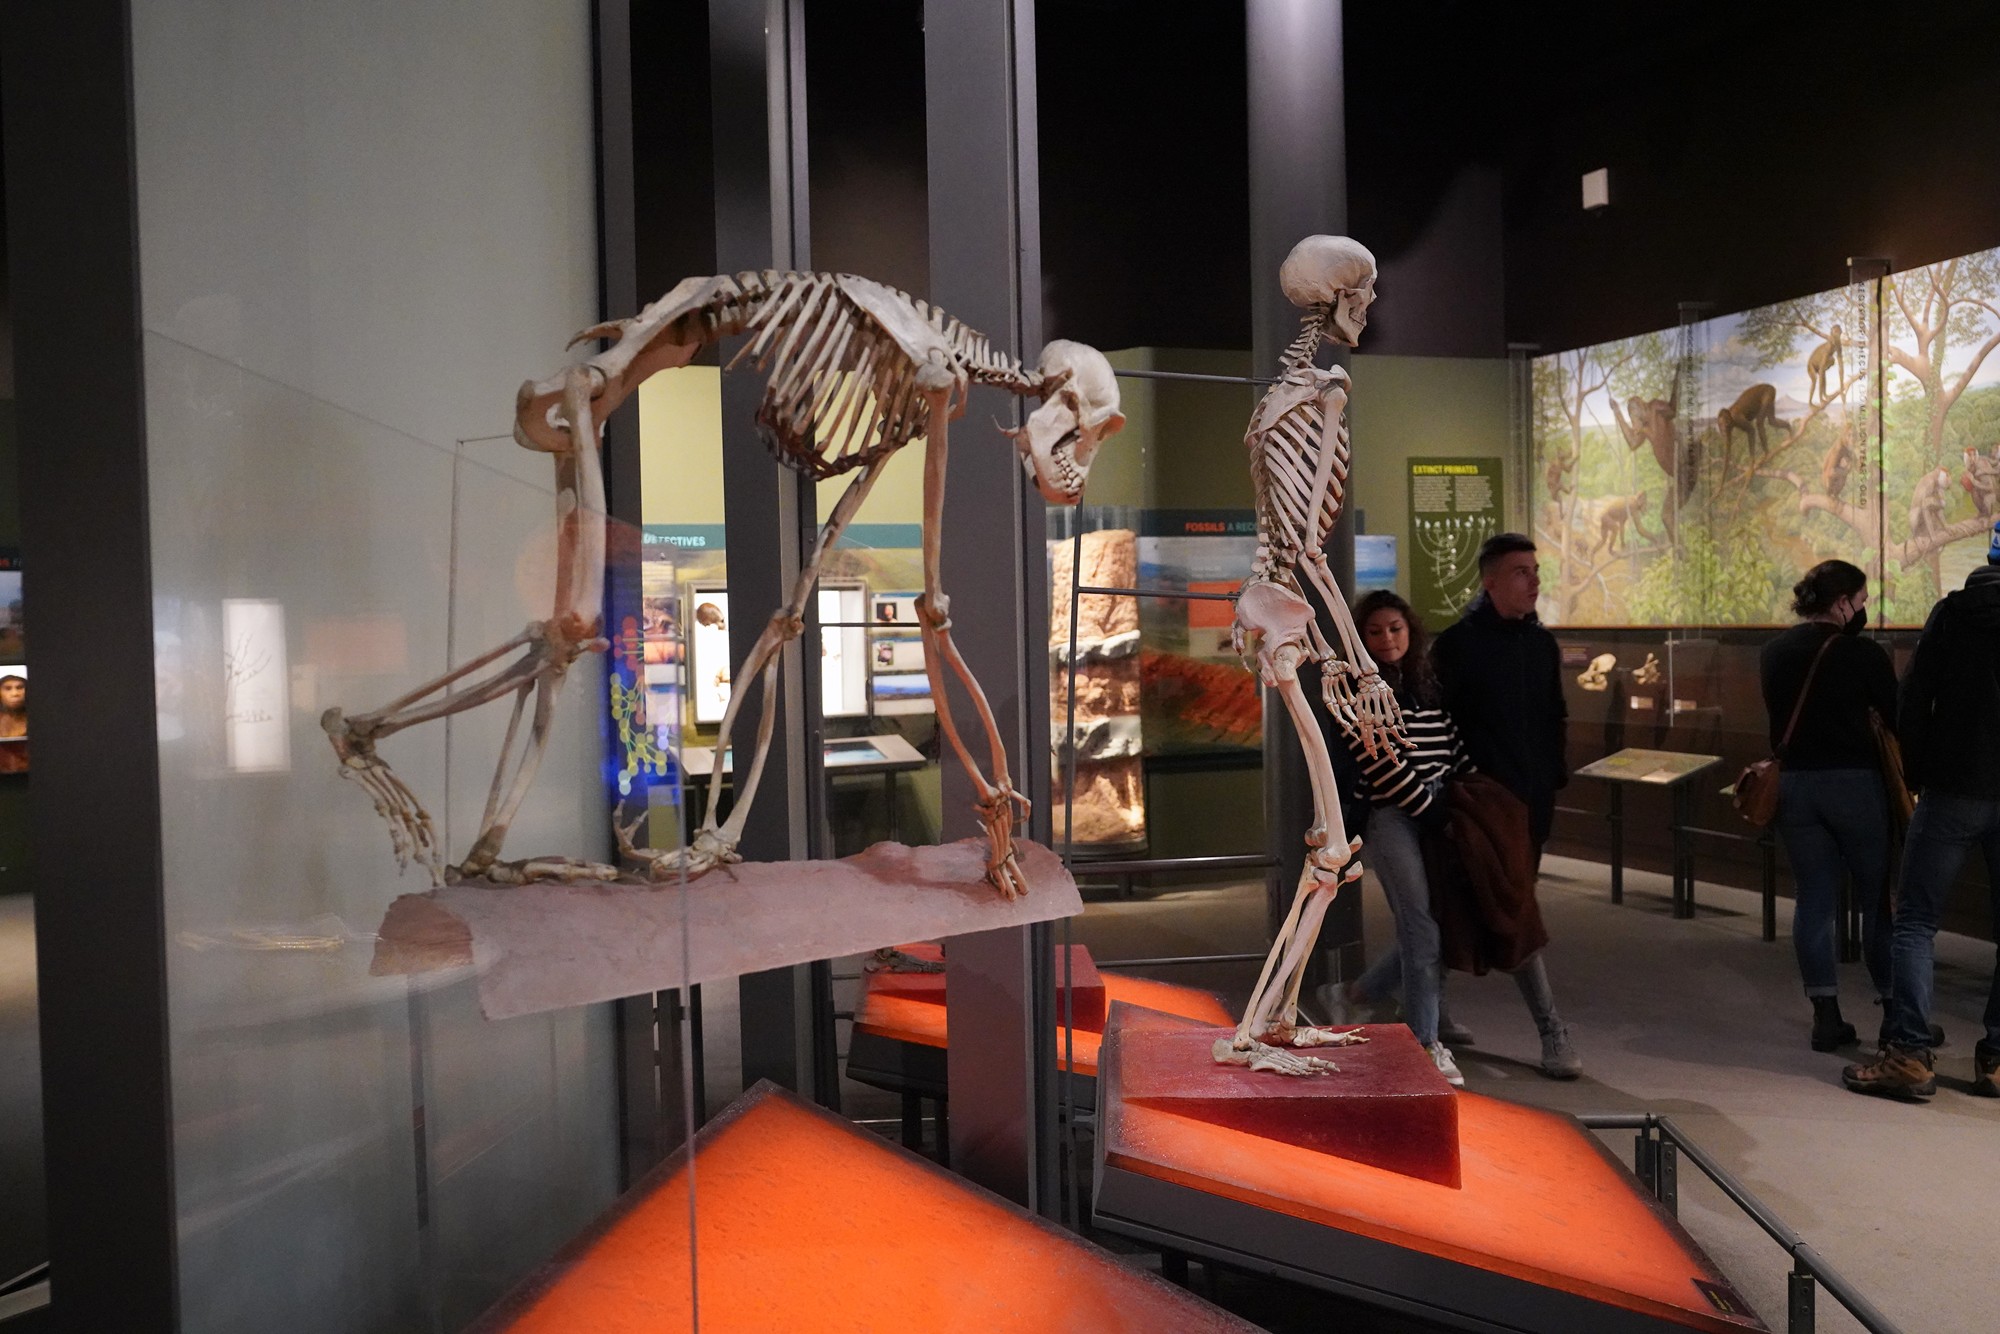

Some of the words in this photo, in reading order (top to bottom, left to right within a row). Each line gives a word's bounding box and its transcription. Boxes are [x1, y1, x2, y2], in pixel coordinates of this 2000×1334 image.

[1413, 465, 1442, 474] EXTINCT
[1443, 465, 1478, 474] PRIMATES
[1186, 522, 1225, 532] FOSSILS
